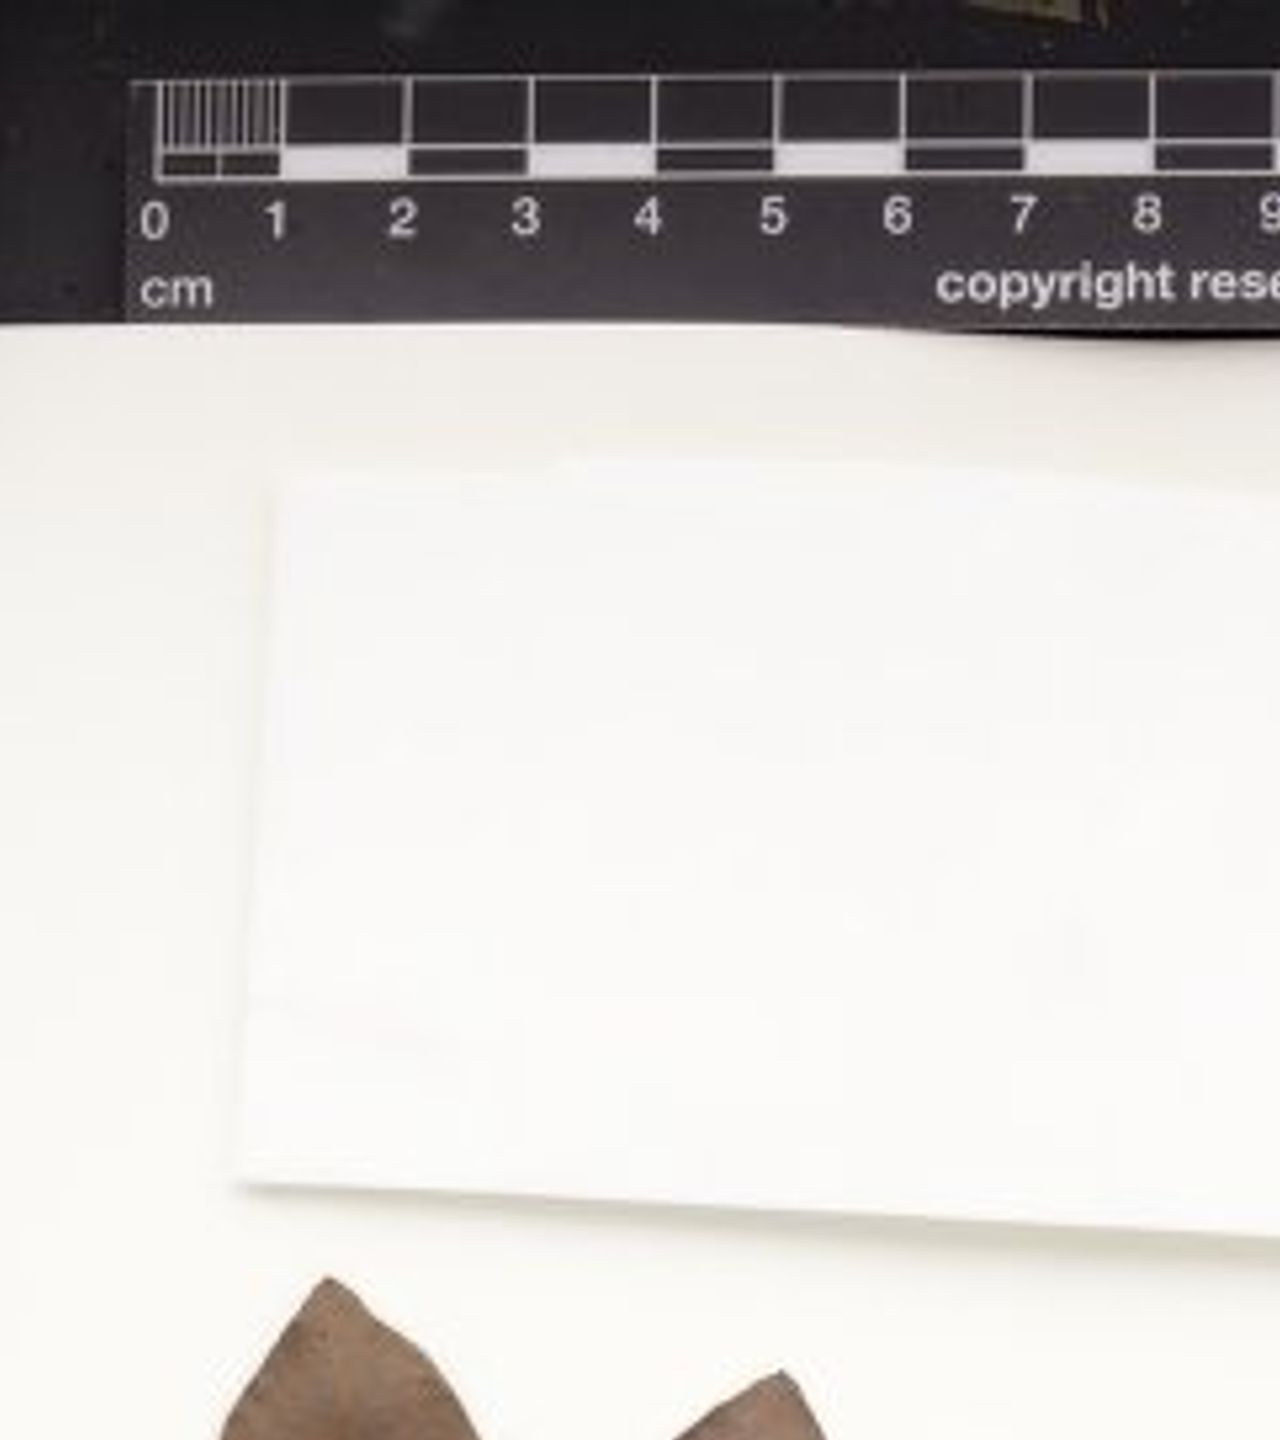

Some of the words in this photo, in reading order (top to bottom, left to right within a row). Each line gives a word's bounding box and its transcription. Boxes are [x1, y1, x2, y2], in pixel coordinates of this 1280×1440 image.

[140, 200, 170, 241] 0
[265, 200, 286, 239] 1
[388, 198, 417, 238] 2
[511, 196, 542, 236] 3
[633, 196, 662, 235] 4
[760, 196, 788, 235] 5
[883, 195, 912, 235] 6
[1010, 195, 1039, 234] 7
[1132, 195, 1162, 234] 8
[140, 274, 214, 308] cm
[936, 260, 1175, 310] copyright
